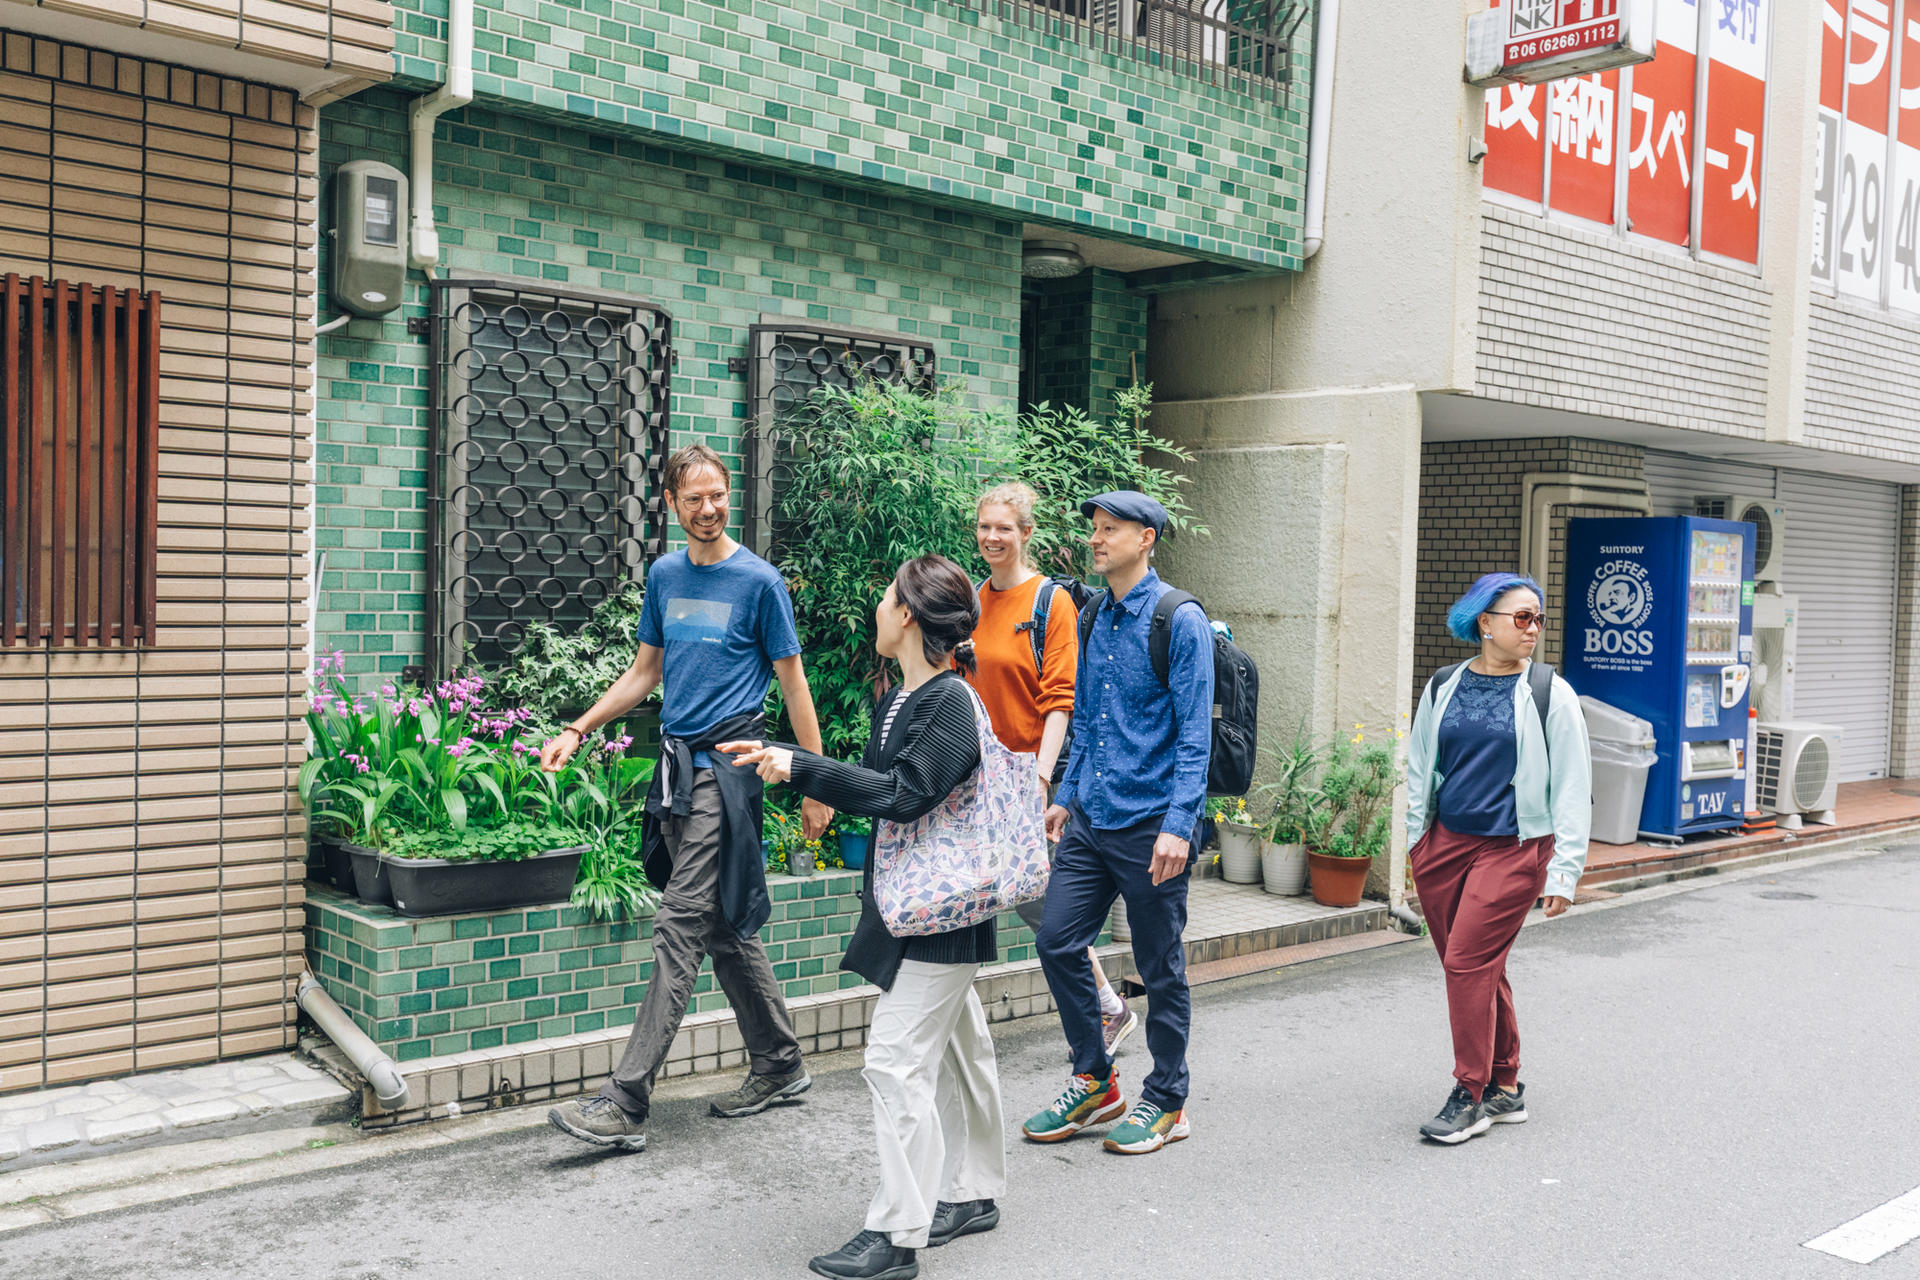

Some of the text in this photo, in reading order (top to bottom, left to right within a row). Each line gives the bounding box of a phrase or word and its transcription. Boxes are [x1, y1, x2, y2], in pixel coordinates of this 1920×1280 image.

[1521, 24, 1615, 57] 06 (6266) 1112
[1600, 545, 1644, 554] SUNTORY
[1595, 560, 1648, 581] COFFEE
[1584, 628, 1654, 655] BOSS
